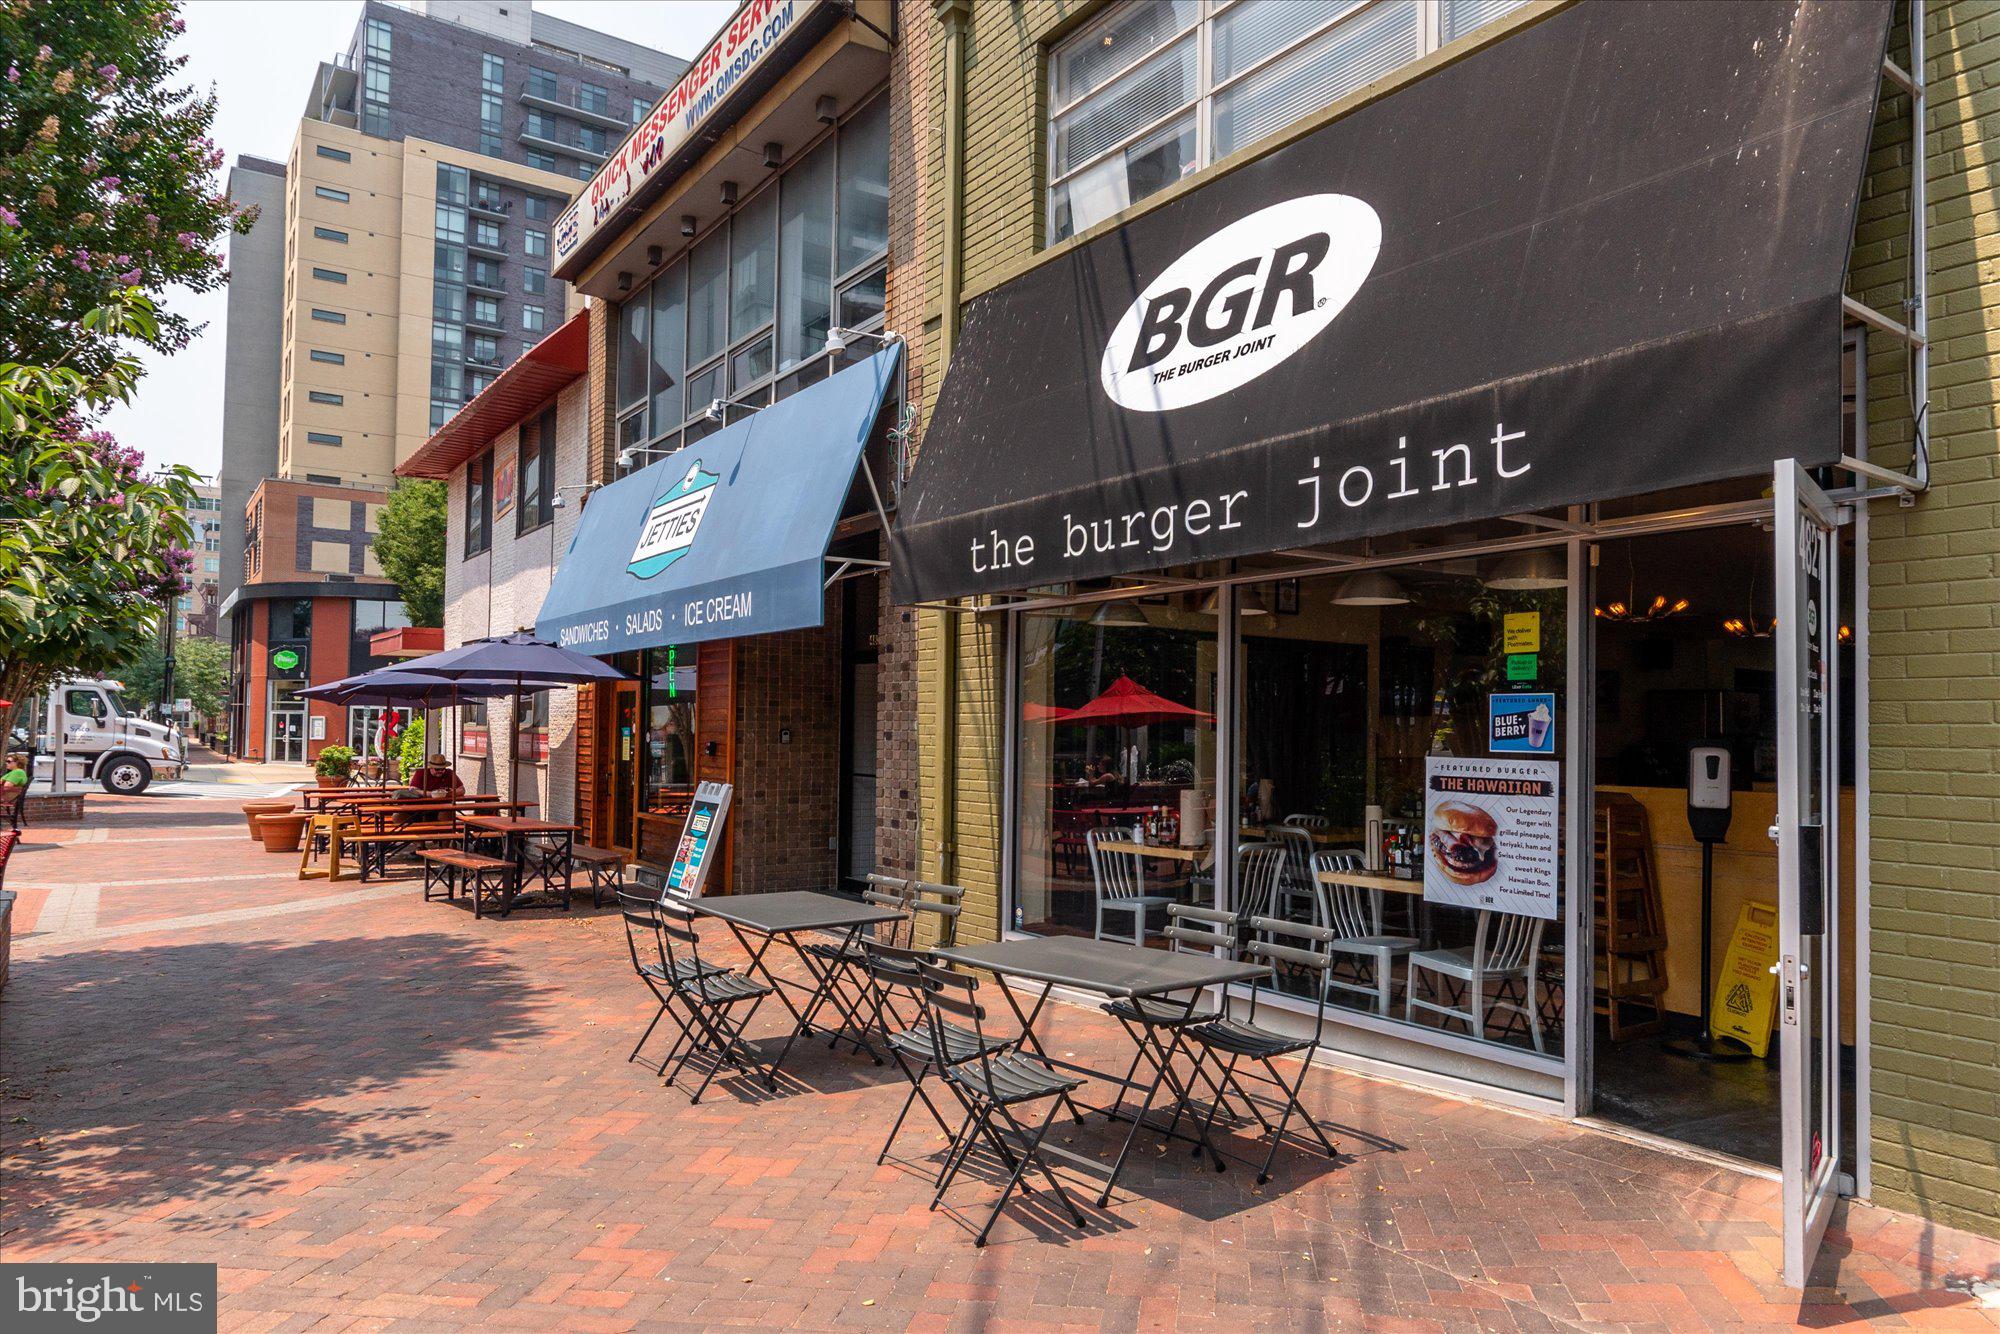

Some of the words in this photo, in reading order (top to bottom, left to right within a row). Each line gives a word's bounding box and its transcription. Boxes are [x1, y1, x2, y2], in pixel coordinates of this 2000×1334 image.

[685, 0, 794, 130] WWW.QMSDC.COM
[591, 146, 629, 206] QUICK
[631, 41, 722, 164] MESSENGER
[726, 0, 781, 58] SERV
[1127, 231, 1331, 375] BGR
[1153, 367, 1183, 385] THE
[1178, 350, 1231, 377] BURGER
[1233, 334, 1277, 359] JOINT
[970, 529, 1035, 574] the
[1062, 489, 1249, 559] burger
[1297, 422, 1533, 529] joint
[639, 507, 701, 550] JETTIES
[560, 620, 609, 647] SANDWICHES
[625, 608, 663, 636] SALADS
[684, 600, 704, 627] ICE
[706, 591, 752, 623] CREAM
[668, 644, 676, 699] PEN
[1495, 714, 1522, 727] BLUE-
[1495, 724, 1526, 737] BERRY
[1440, 777, 1464, 790] THE
[1467, 778, 1542, 795] HAWAIIAN
[1506, 806, 1518, 814] Our
[1519, 806, 1552, 817] Legendary
[1516, 818, 1537, 828] Burger
[1538, 819, 1552, 828] with
[1499, 829, 1519, 838] grilled
[1520, 831, 1552, 842] pineapple,
[1499, 840, 1524, 850] teriyaki,
[1525, 842, 1538, 850] ham
[1539, 844, 1552, 852] and
[1498, 851, 1514, 859] Swiss
[1515, 853, 1537, 862] cheese
[1514, 866, 1533, 874] sweet
[1533, 867, 1552, 877] Kings
[1508, 876, 1536, 886] Hawaiian
[1536, 878, 1551, 888] Bun.
[1513, 888, 1535, 898] Limited
